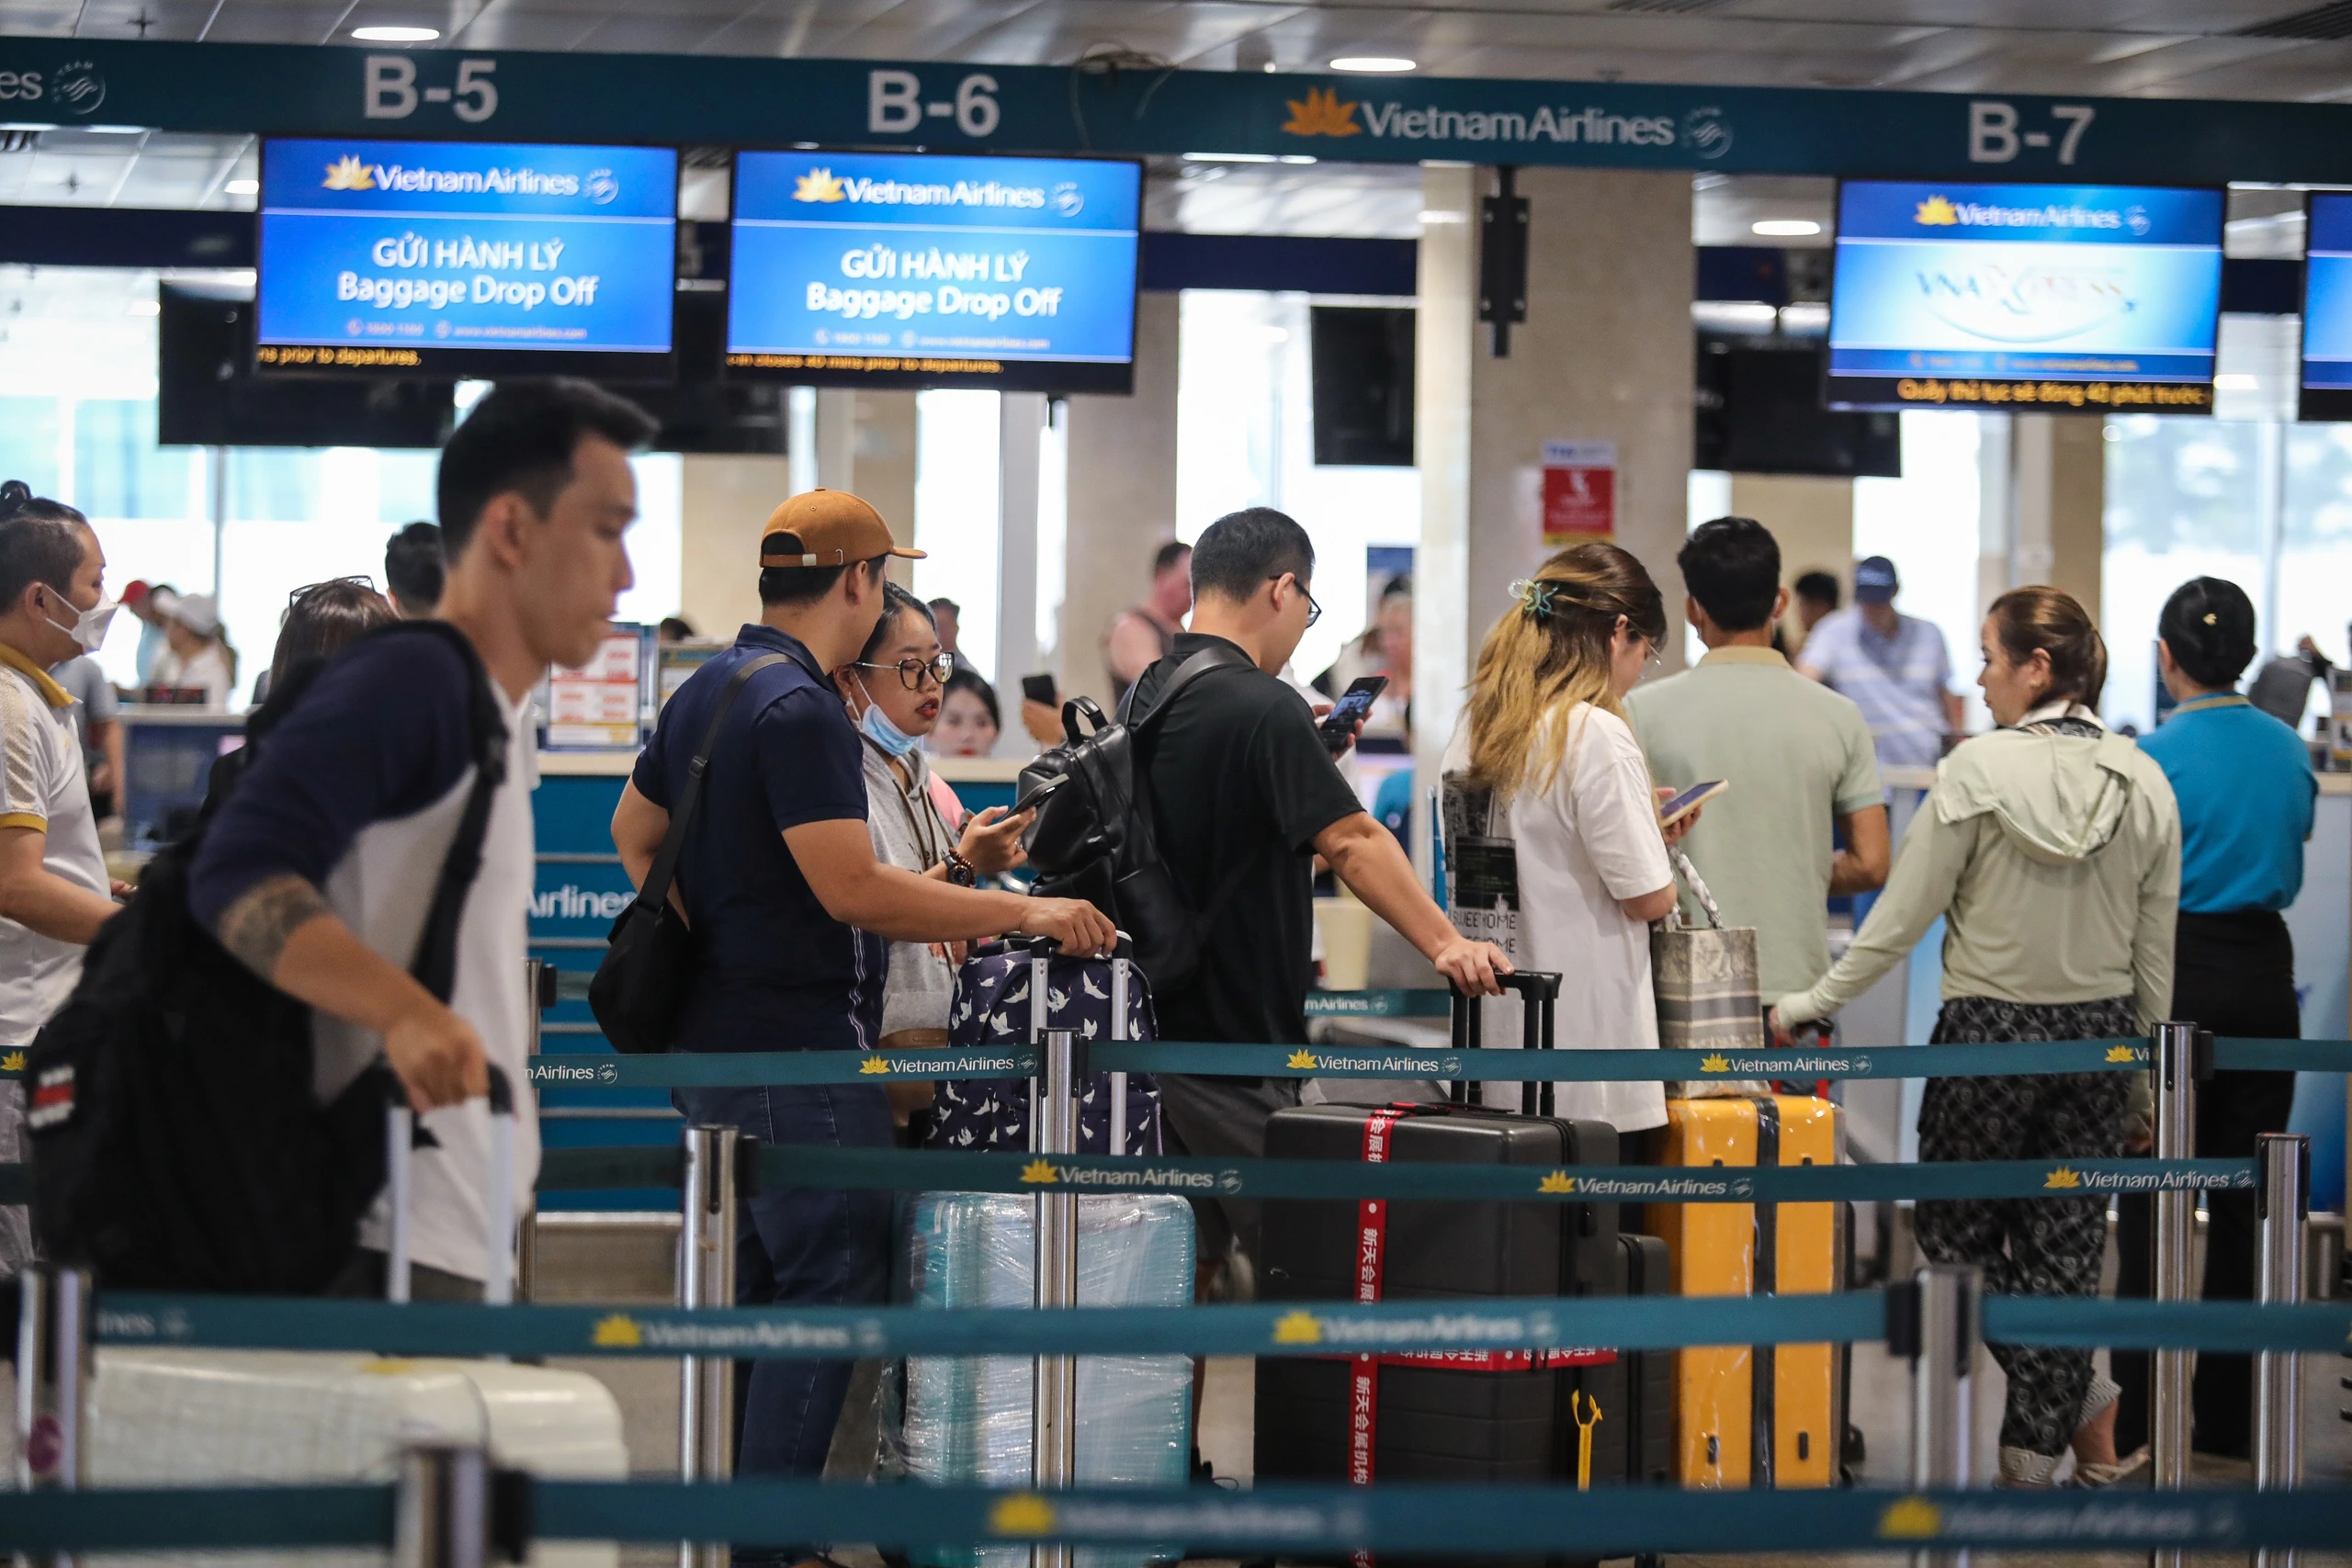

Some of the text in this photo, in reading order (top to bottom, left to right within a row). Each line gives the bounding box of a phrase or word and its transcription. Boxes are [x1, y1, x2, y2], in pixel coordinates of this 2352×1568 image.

[364, 55, 498, 123] B-5
[868, 69, 1001, 138] B-6
[1968, 101, 2096, 165] B-7
[371, 231, 565, 272] GỬI HÀNH LÝ
[840, 243, 1031, 283] GỬI HÀNH LÝ
[337, 271, 600, 311] Baggage Drop Off
[806, 281, 1064, 322] Baggage Drop Off
[535, 1066, 594, 1080] Airlines
[891, 1058, 956, 1073] Vietnam
[956, 1056, 1014, 1072] Airlines
[1318, 1055, 1381, 1070] Vietnam
[1382, 1056, 1439, 1073] Airlines
[1731, 1056, 1849, 1073] Vietnam Airlines
[1059, 1166, 1214, 1188] Vietnam Airlines
[1577, 1177, 1727, 1195] Vietnam Airlines
[2082, 1169, 2230, 1189] Vietnam Airlines
